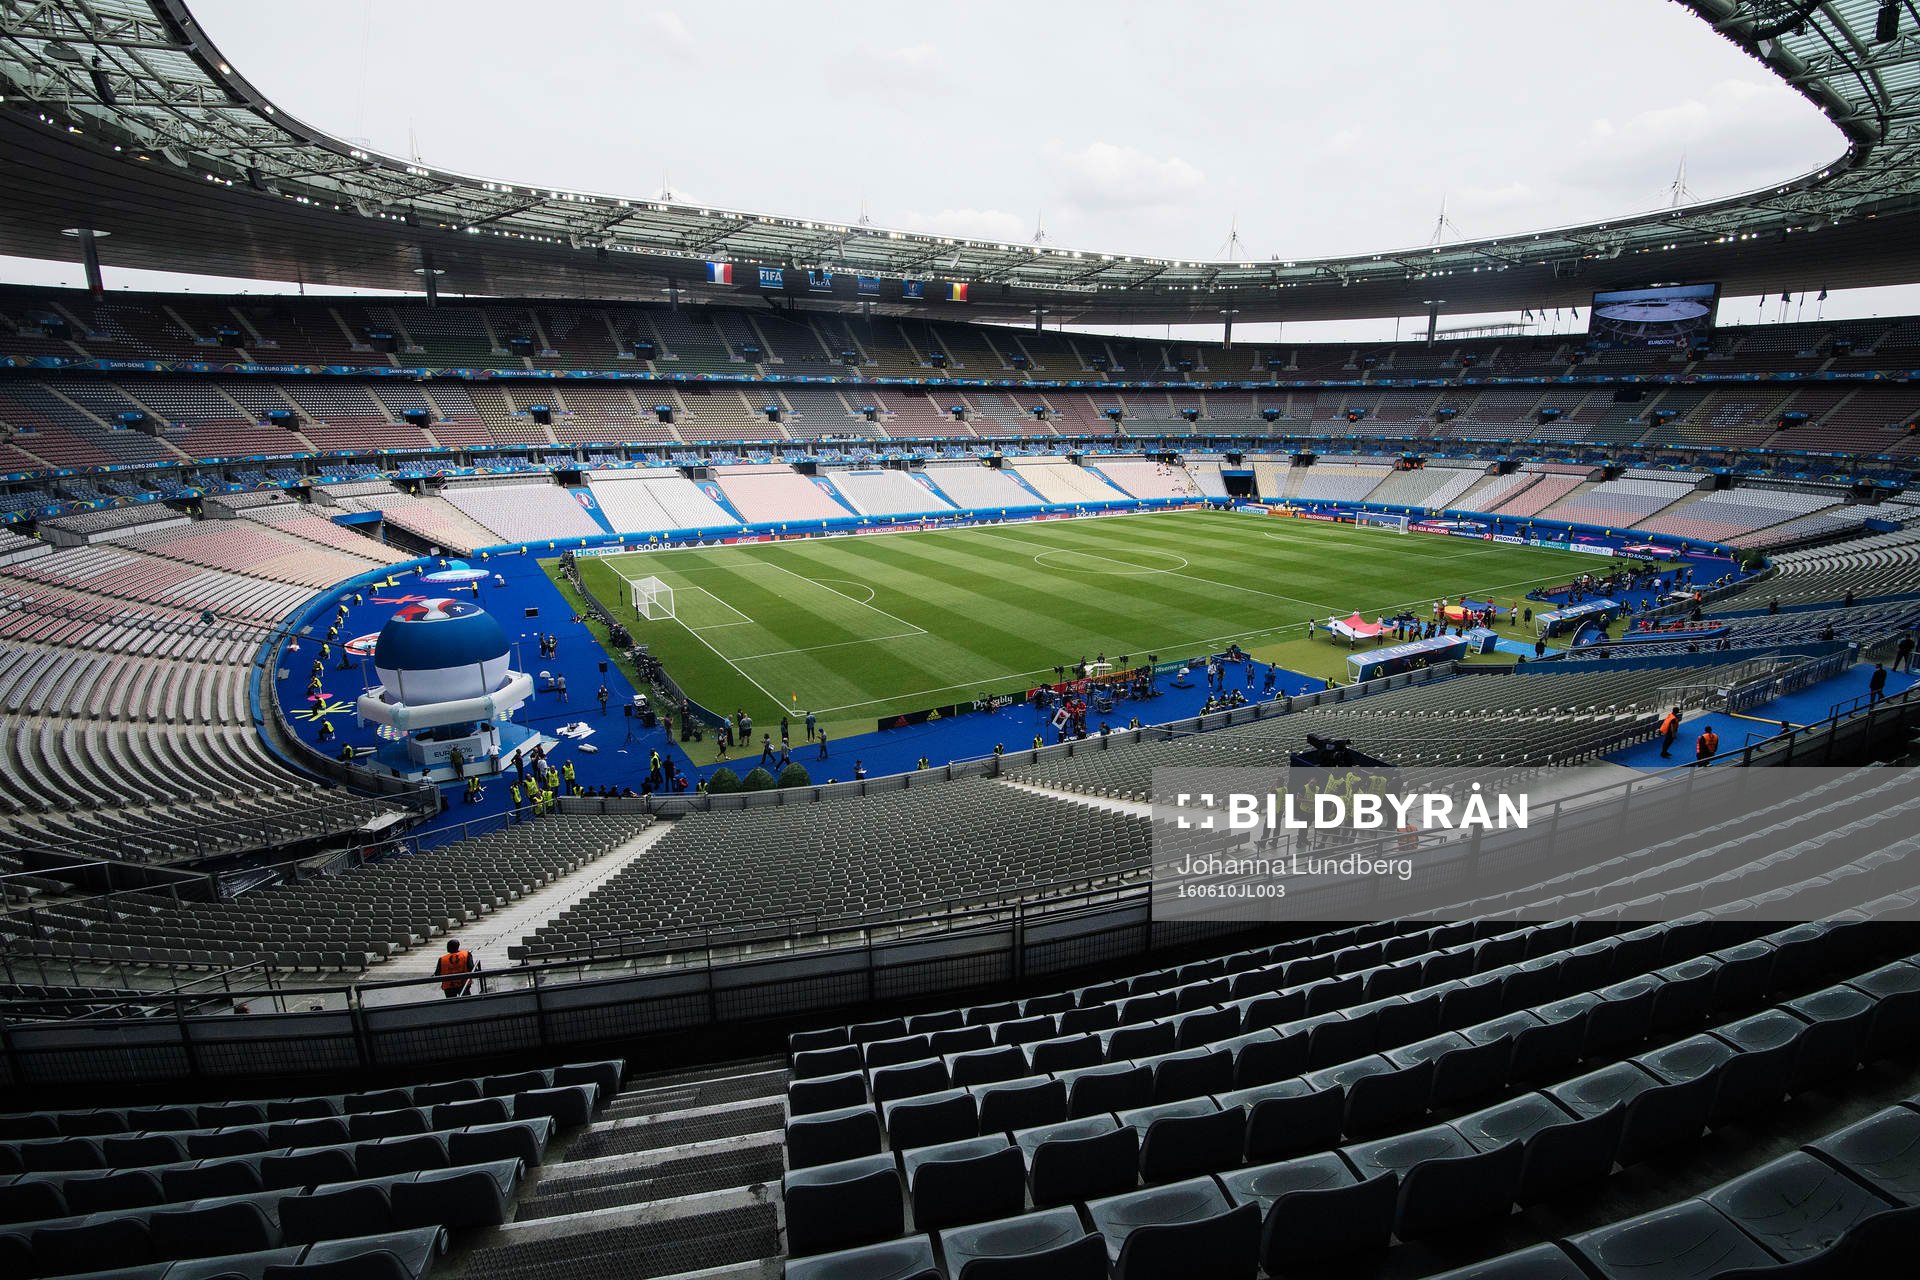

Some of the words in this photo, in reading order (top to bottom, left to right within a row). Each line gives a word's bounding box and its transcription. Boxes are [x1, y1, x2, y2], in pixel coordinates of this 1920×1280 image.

[760, 270, 782, 281] FIFA
[637, 543, 672, 552] SOCAR
[575, 548, 620, 557] Hisense
